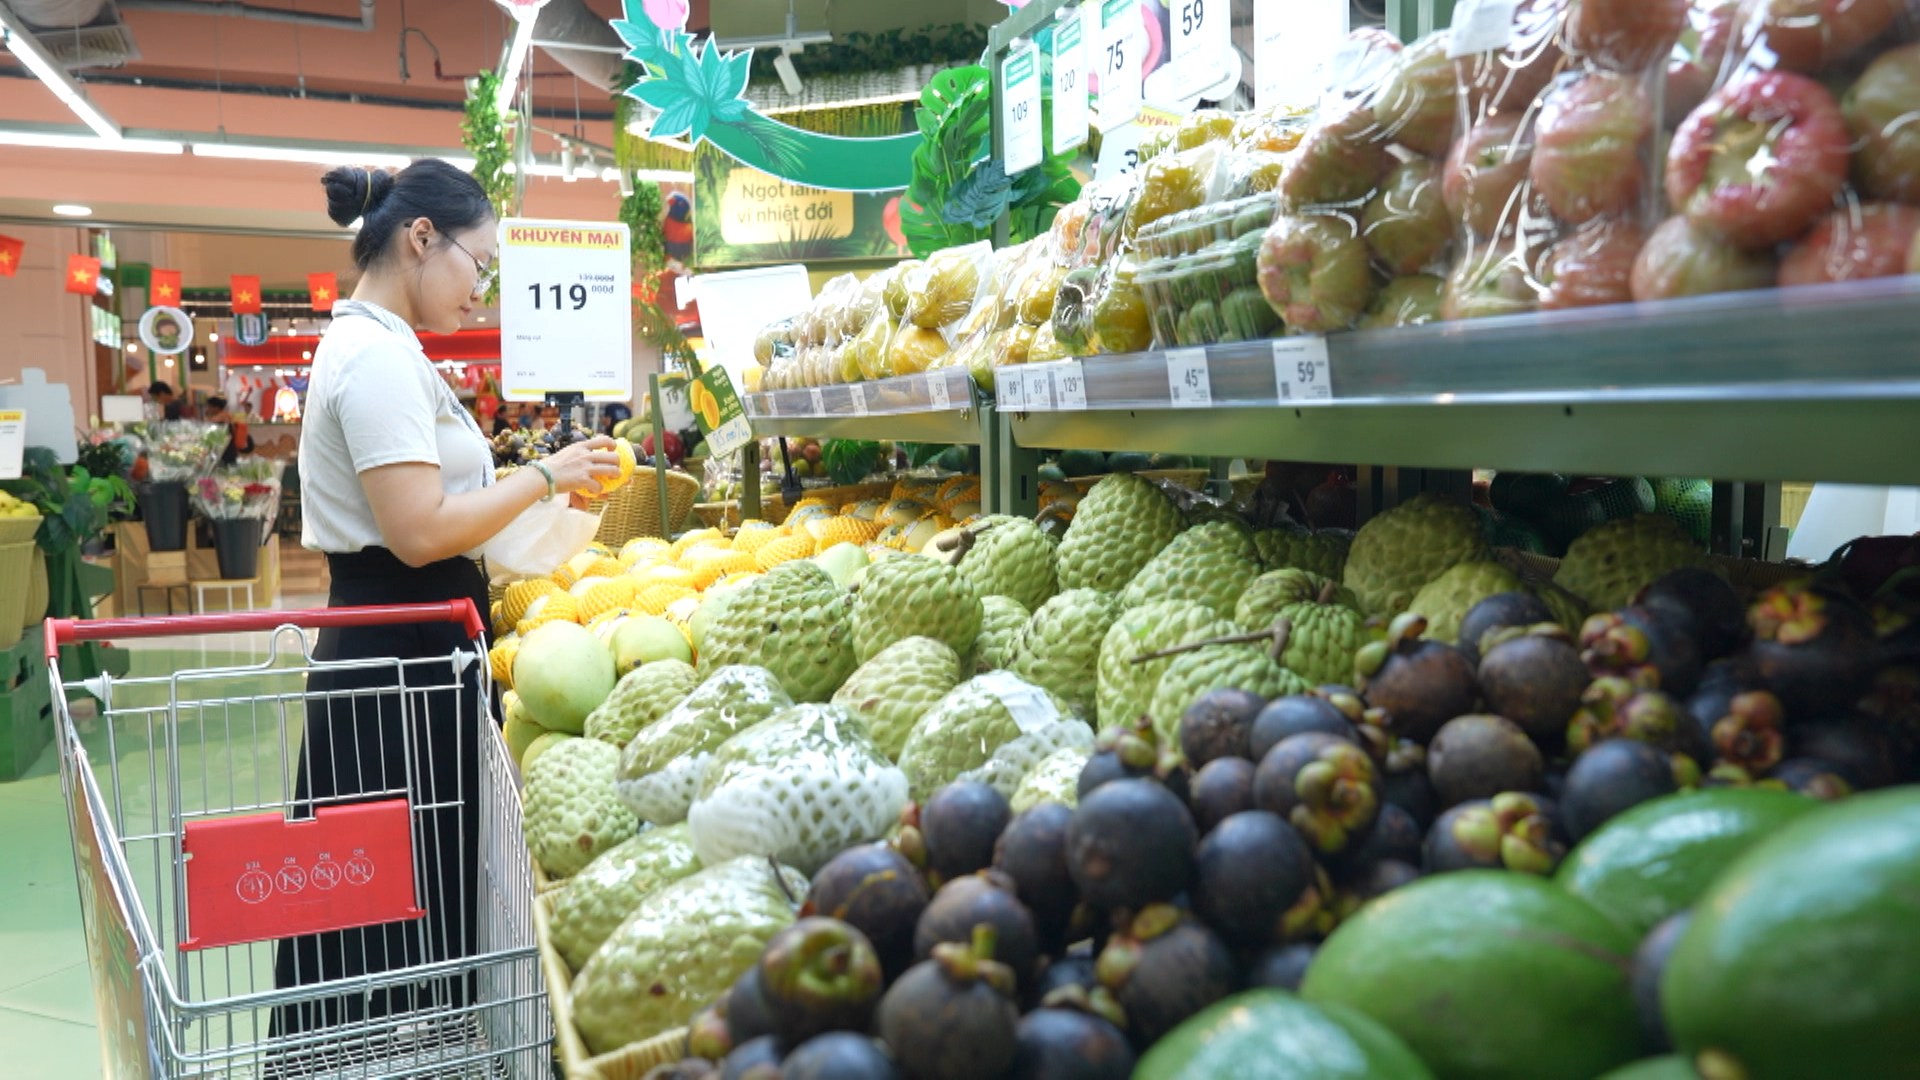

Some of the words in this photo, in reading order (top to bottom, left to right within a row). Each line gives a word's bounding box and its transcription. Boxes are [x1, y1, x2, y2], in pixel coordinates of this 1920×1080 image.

[1182, 0, 1204, 36] 59
[1107, 39, 1124, 75] 75
[1060, 69, 1075, 94] 120
[1012, 100, 1028, 123] 109
[742, 182, 785, 202] Ngọt
[757, 204, 799, 223] nhiệt
[805, 201, 833, 220] đới
[528, 282, 587, 310] 119
[1185, 368, 1198, 388] 45
[1297, 360, 1315, 383] 59
[1064, 377, 1077, 392] 129
